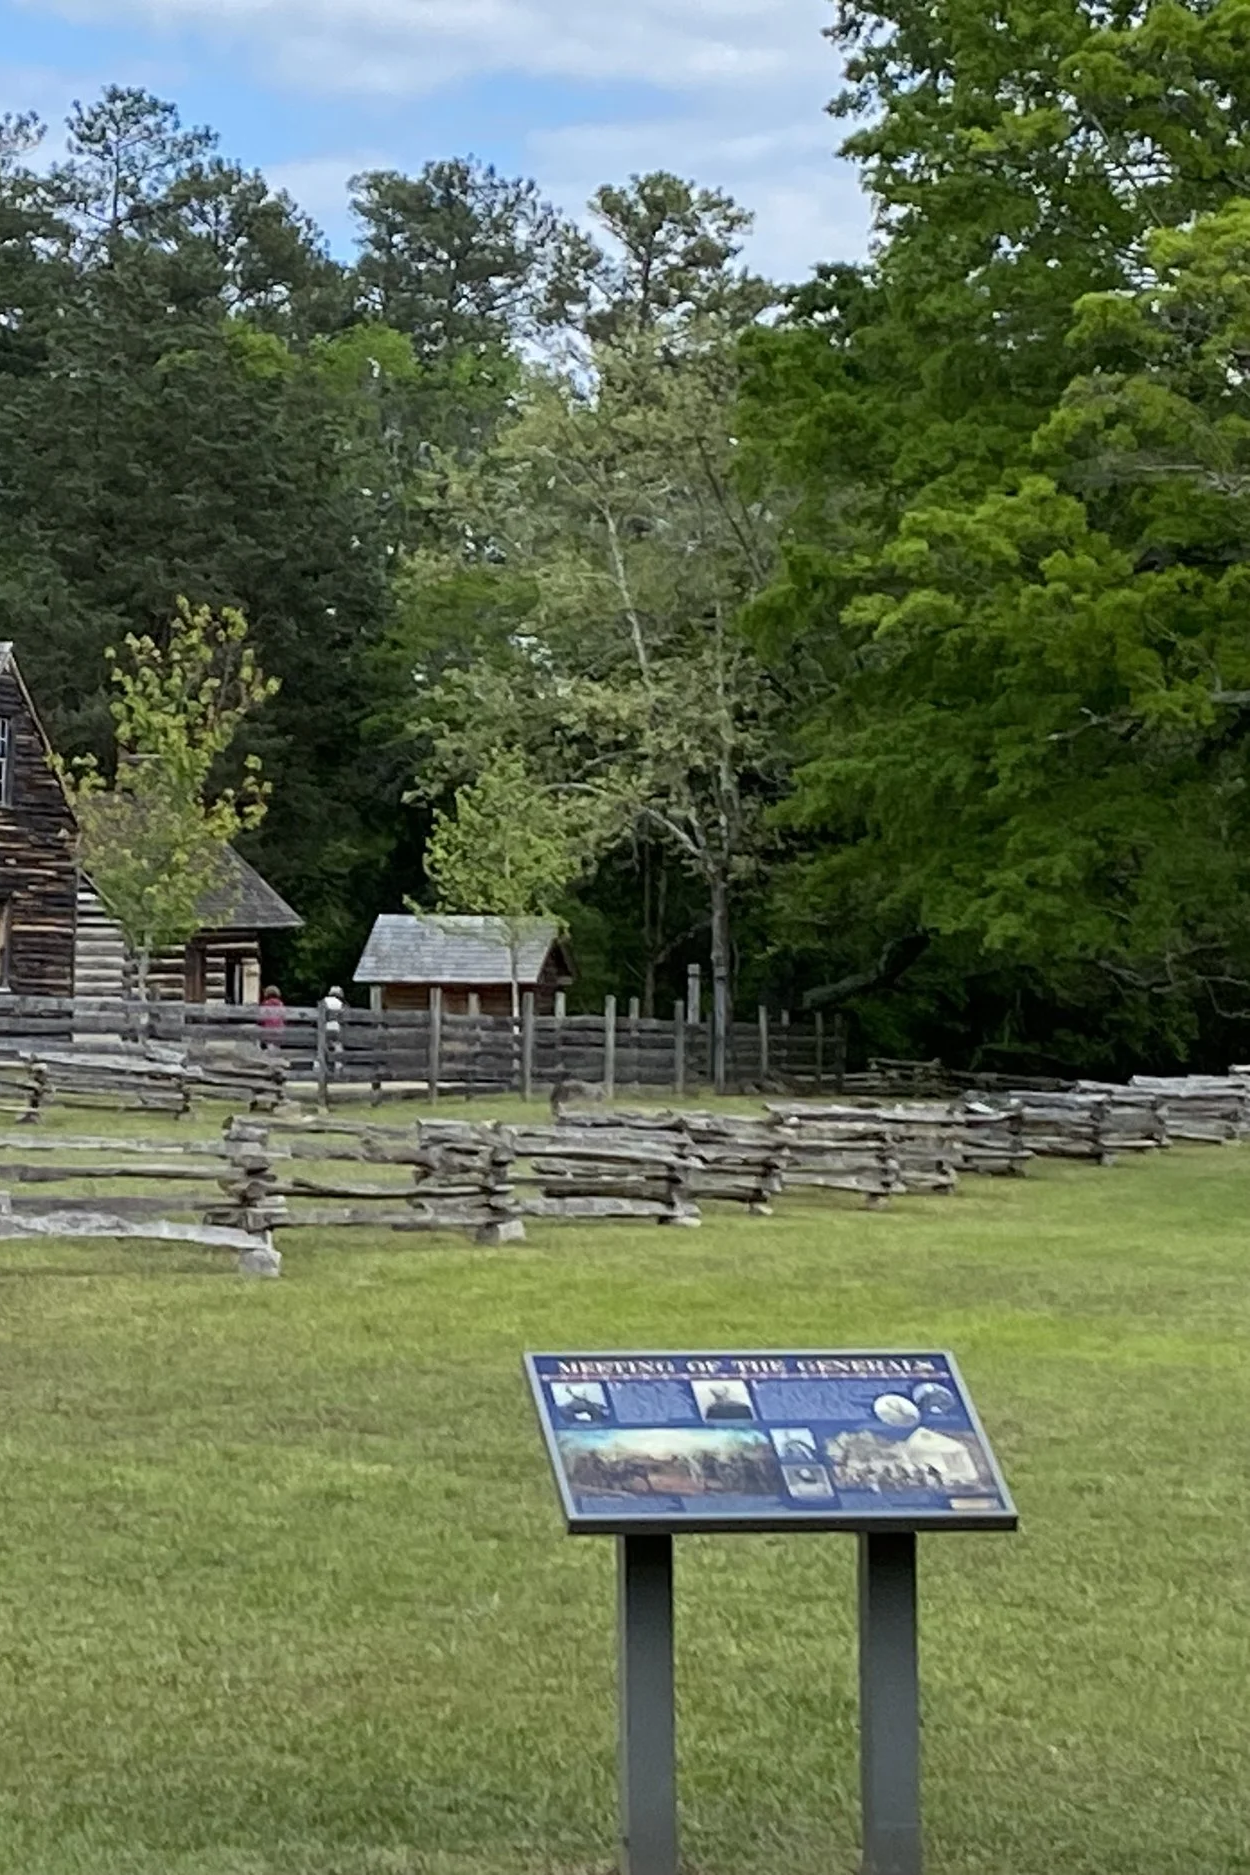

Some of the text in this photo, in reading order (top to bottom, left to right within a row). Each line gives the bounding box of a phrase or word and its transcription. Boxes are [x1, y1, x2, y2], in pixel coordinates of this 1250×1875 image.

[558, 1359, 935, 1375] MEETING OF THE GENERALS
